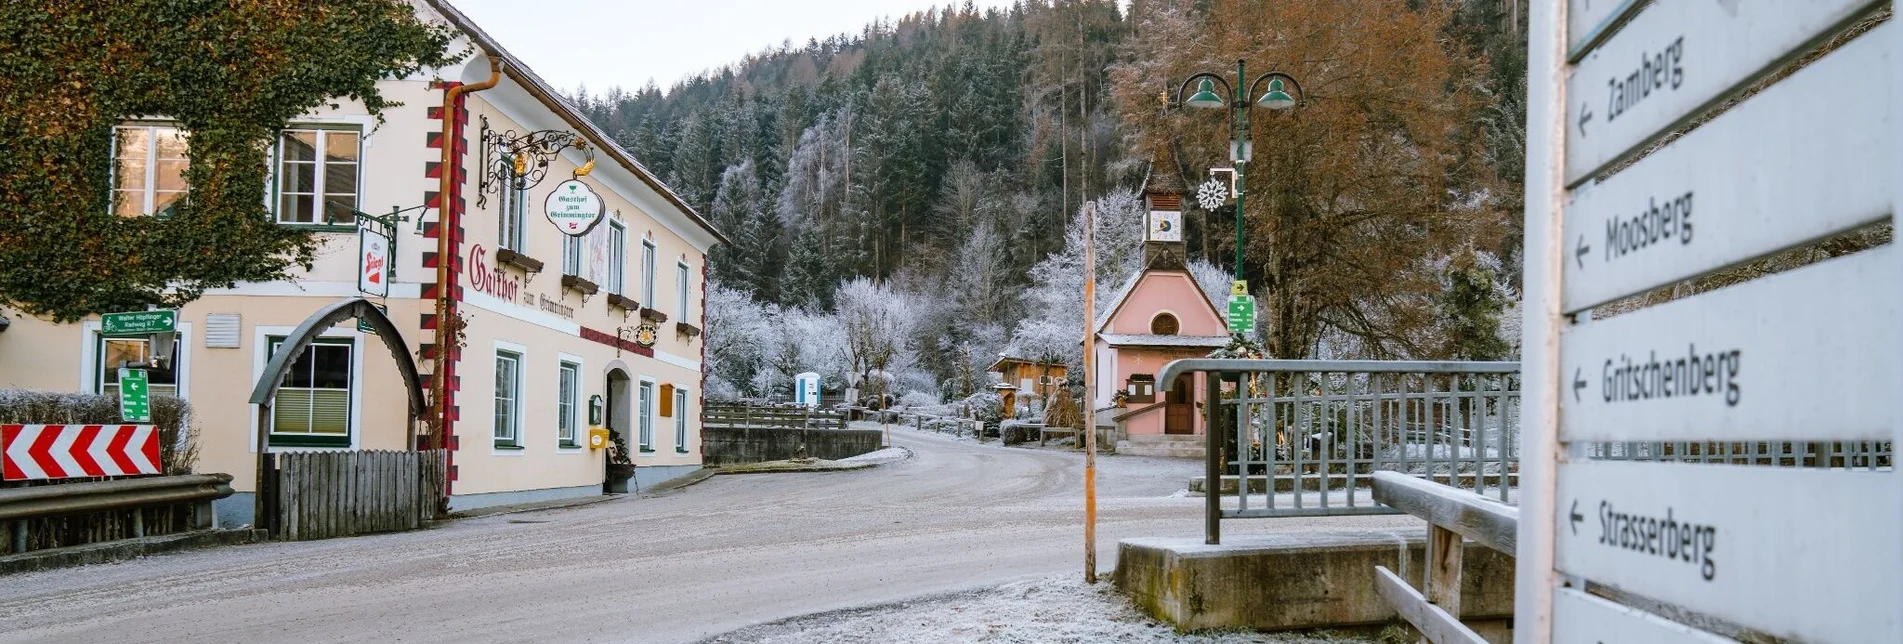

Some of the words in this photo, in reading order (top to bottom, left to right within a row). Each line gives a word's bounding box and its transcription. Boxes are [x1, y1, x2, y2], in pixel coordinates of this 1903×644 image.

[1607, 35, 1684, 122] Zamberg
[1605, 191, 1694, 262] Moosberg
[1602, 343, 1741, 407] Gritschenberg
[1599, 500, 1717, 581] Strasserberg
